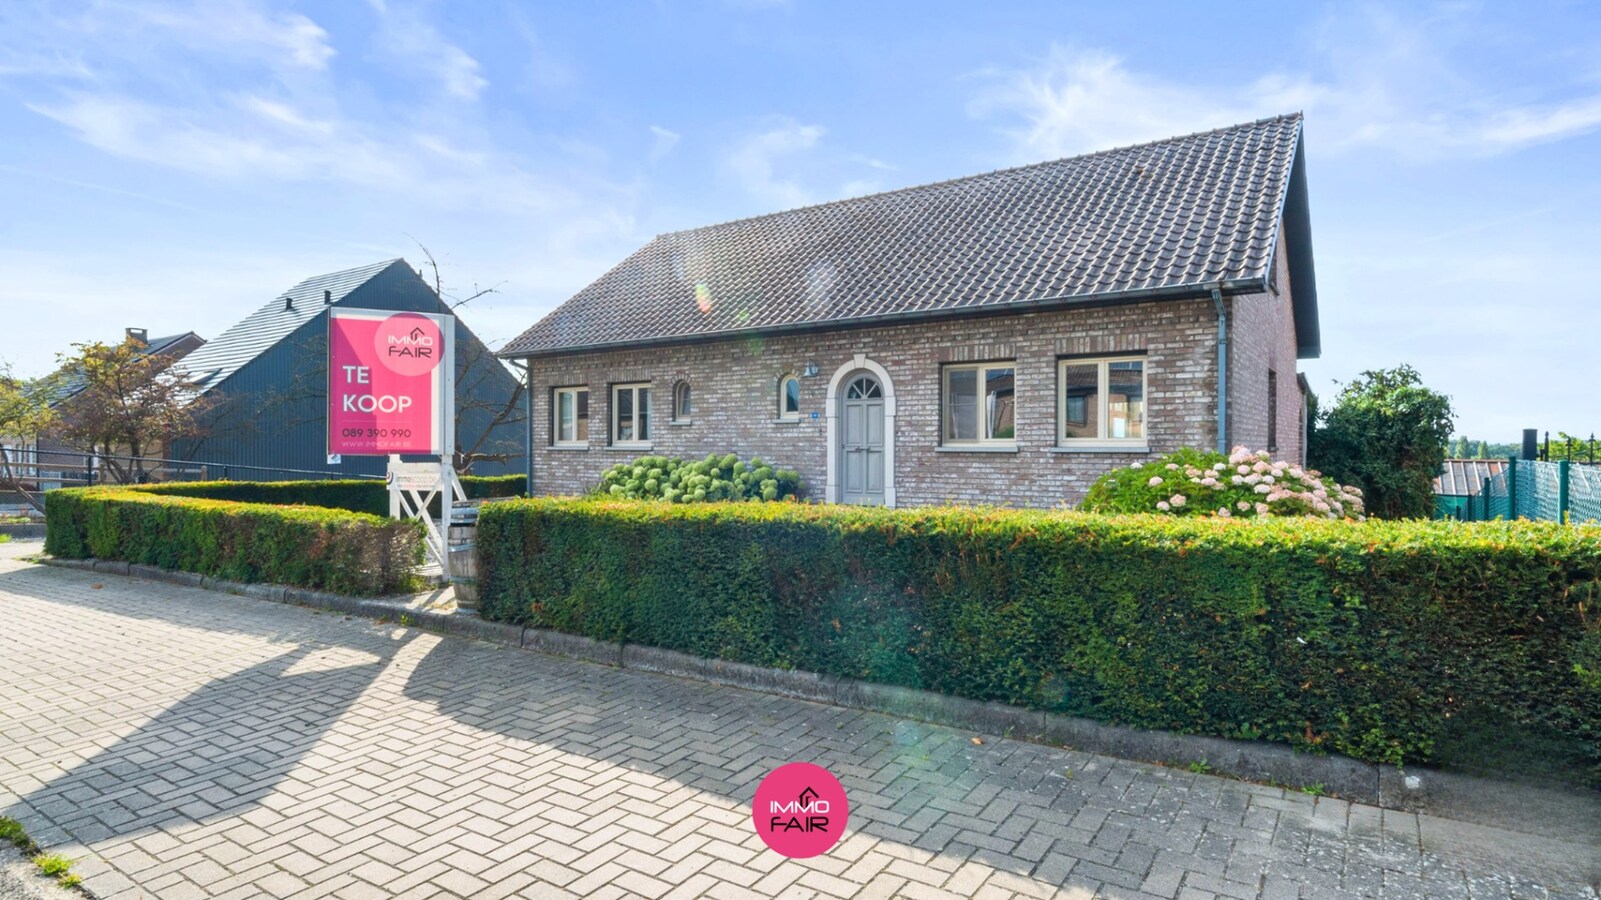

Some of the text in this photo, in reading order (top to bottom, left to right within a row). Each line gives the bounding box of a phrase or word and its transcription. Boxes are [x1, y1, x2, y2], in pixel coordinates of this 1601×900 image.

[387, 335, 433, 346] IMMO
[388, 346, 433, 359] FAIR
[342, 365, 370, 384] TE
[342, 394, 412, 413] KOOP
[342, 428, 412, 438] 089 390 990
